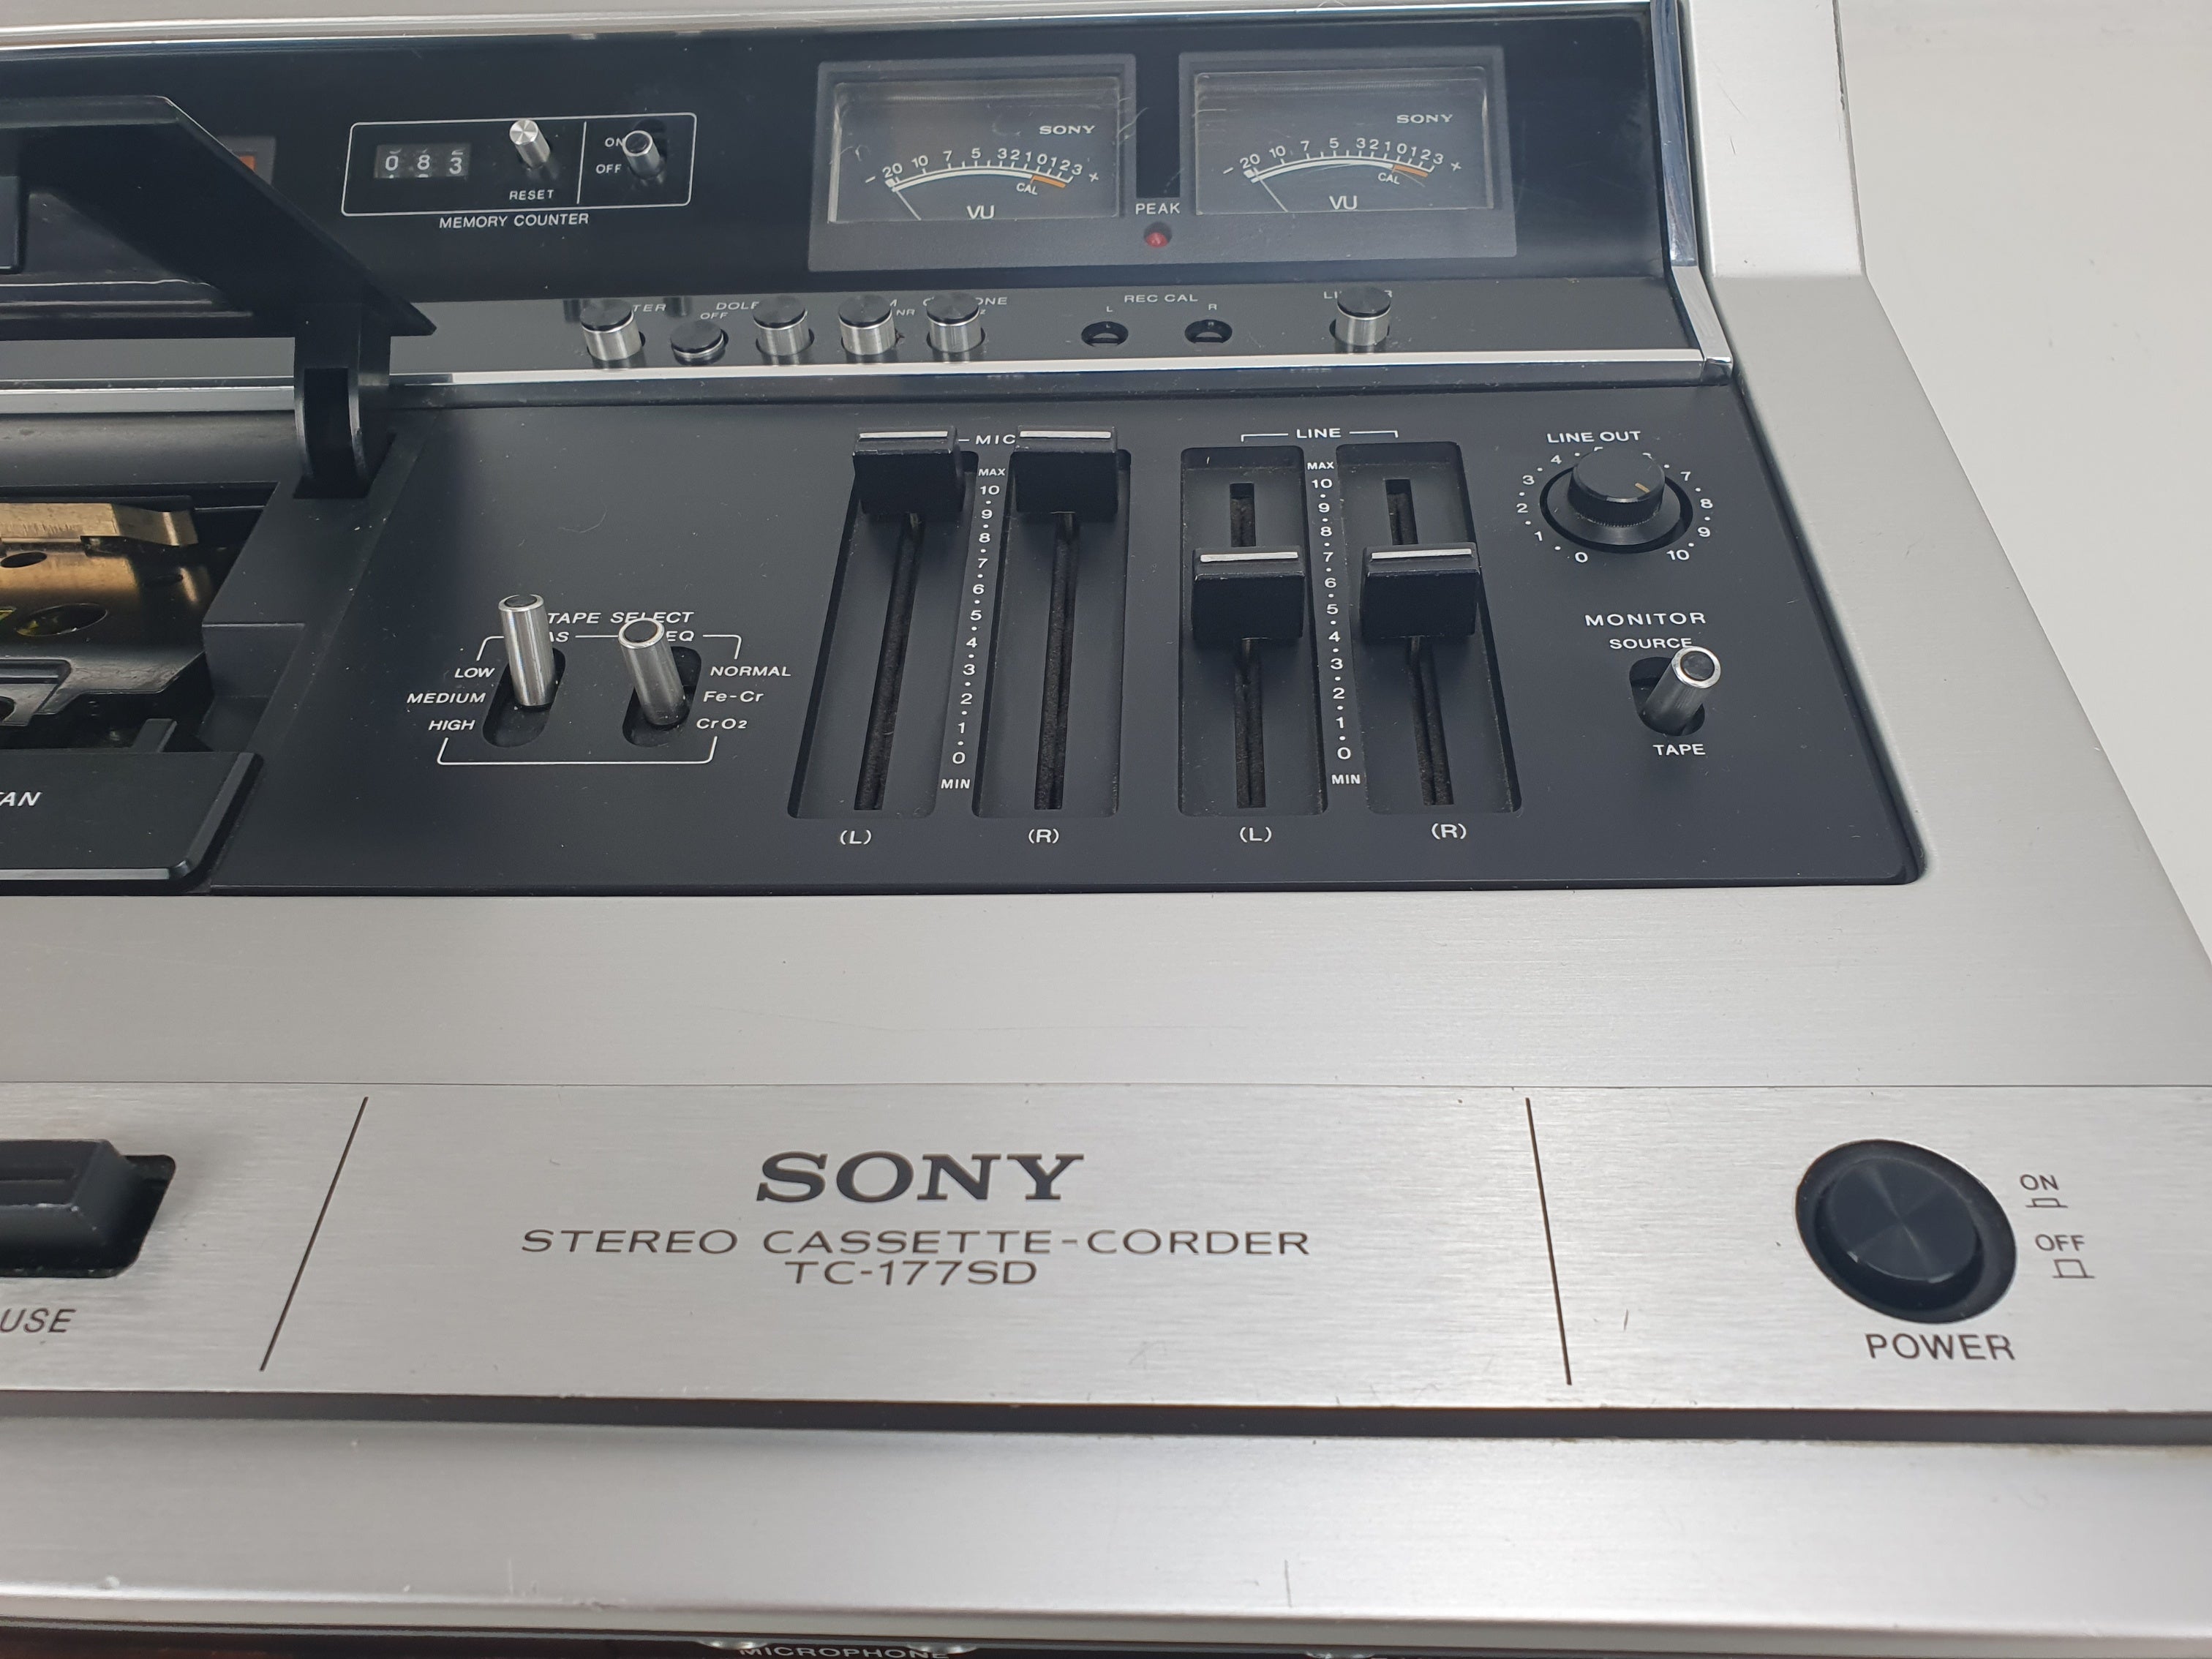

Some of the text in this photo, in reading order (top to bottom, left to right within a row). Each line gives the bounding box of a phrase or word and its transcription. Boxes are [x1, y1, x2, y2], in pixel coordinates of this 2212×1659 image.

[1396, 114, 1453, 124] SONY
[1039, 125, 1095, 135] SONY
[604, 137, 624, 148] ON
[1239, 154, 1261, 170] 20
[1268, 145, 1286, 159] 10
[1300, 140, 1309, 151] 7
[1329, 138, 1339, 148] 5
[1355, 138, 1366, 149] 3
[1369, 138, 1379, 150] 2
[1396, 143, 1407, 156] 0
[1420, 148, 1432, 160] 2
[1432, 151, 1444, 165] 3
[882, 162, 903, 178] 20
[911, 155, 929, 168] 10
[943, 150, 952, 162] 7
[971, 147, 981, 159] 5
[997, 148, 1007, 159] 3
[1010, 149, 1020, 161] 2
[1037, 153, 1047, 166] 0
[1059, 159, 1071, 173] 2
[1071, 162, 1083, 176] 3
[595, 164, 622, 174] OFF
[1377, 170, 1401, 185] CAL
[1016, 181, 1039, 195] CAL
[509, 189, 554, 200] RESET
[1135, 202, 1181, 215] PEAK
[1329, 195, 1358, 211] VU
[966, 205, 995, 220] VU
[438, 212, 589, 229] MEMORY COUNTER
[1124, 293, 1198, 303] REC CAL
[633, 304, 666, 312] TER
[700, 312, 728, 320] OFF
[1296, 428, 1342, 439] LINE
[1546, 431, 1641, 443] LINE OUT
[975, 434, 1016, 445] MIC
[1550, 454, 1562, 464] 4
[1307, 461, 1335, 470] MAX
[978, 468, 1006, 476] MAX
[1680, 471, 1691, 481] 7
[1312, 478, 1333, 489] 10
[1522, 475, 1535, 485] 3
[979, 485, 1000, 495] 10
[1318, 503, 1330, 513] 9
[1516, 503, 1529, 514] 2
[1700, 498, 1713, 509] 8
[981, 509, 993, 519] 9
[1320, 526, 1333, 537] 8
[1534, 531, 1543, 541] 1
[1697, 527, 1711, 538] 9
[979, 533, 990, 543] 8
[1323, 552, 1333, 563] 7
[1575, 552, 1588, 563] 0
[1666, 549, 1690, 560] 10
[978, 557, 988, 568] 7
[1324, 577, 1337, 588] 6
[972, 584, 985, 595] 6
[1326, 603, 1339, 615] 5
[548, 612, 601, 624] TAPE
[970, 609, 982, 621] 5
[1584, 612, 1706, 626] MONITOR
[665, 630, 695, 642] EQ
[1328, 631, 1341, 642] 4
[966, 637, 978, 648] 4
[1609, 638, 1693, 650] SOURCE
[963, 663, 975, 676] 3
[1330, 658, 1343, 670] 3
[454, 667, 495, 678] LOW
[710, 666, 791, 677] NORMAL
[407, 692, 486, 704] MEDIUM
[703, 691, 764, 702] Fe-Cr
[960, 693, 973, 704] 2
[1333, 687, 1345, 699] 2
[428, 719, 475, 731] HIGH
[958, 722, 965, 734] 1
[1336, 716, 1344, 729] 1
[1337, 747, 1351, 760] 0
[1652, 743, 1706, 756] TAPE
[952, 751, 966, 764] 0
[941, 778, 971, 789] MIN
[1331, 774, 1361, 785] MIN
[0, 791, 42, 807] AN
[1028, 828, 1059, 844] (R)
[1239, 827, 1272, 843] (L)
[1431, 823, 1467, 840] (R)
[840, 830, 872, 845] (L)
[755, 1151, 1085, 1204] SONY
[2019, 1173, 2060, 1192] ON
[521, 1228, 1309, 1255] STEREO CASSETTE-CORDER
[2034, 1233, 2085, 1252] OFF
[783, 1259, 1037, 1287] TC-177SD
[1865, 1332, 2016, 1361] POWER
